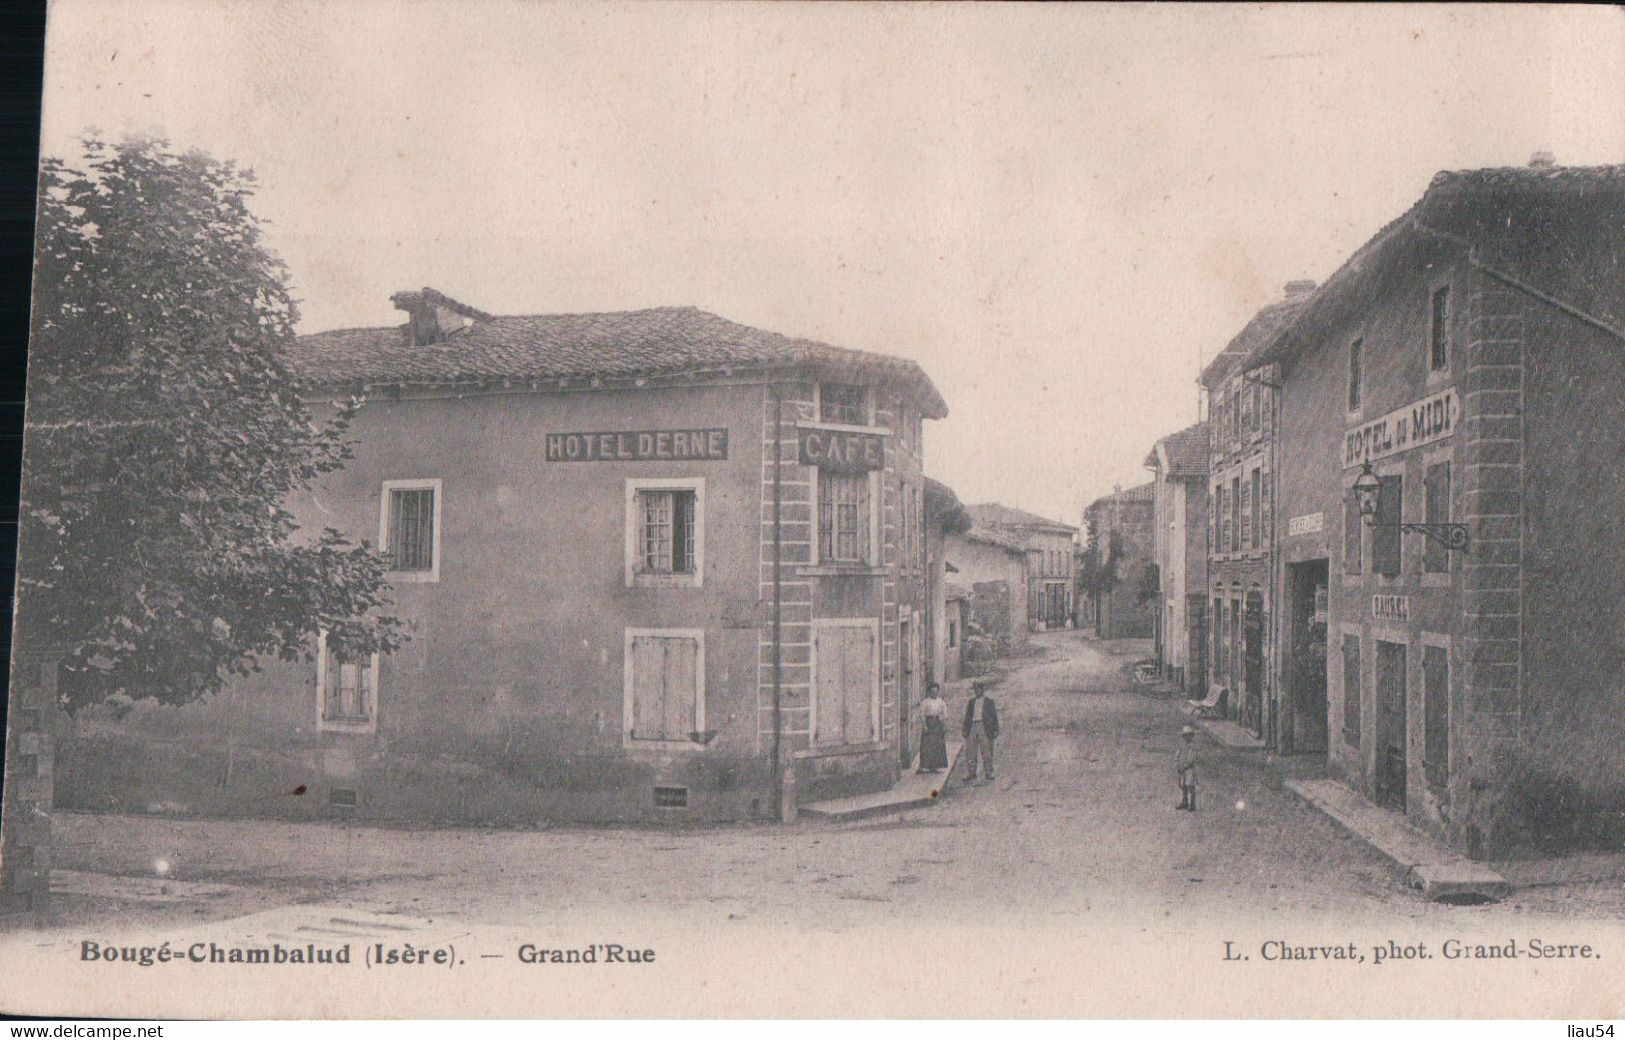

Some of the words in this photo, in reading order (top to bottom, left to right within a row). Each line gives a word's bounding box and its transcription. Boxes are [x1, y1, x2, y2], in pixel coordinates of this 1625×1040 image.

[548, 434, 631, 459] HOTEL
[637, 431, 725, 458] DERNE
[1346, 420, 1392, 461] HOTEL
[1412, 394, 1451, 440] MIDI
